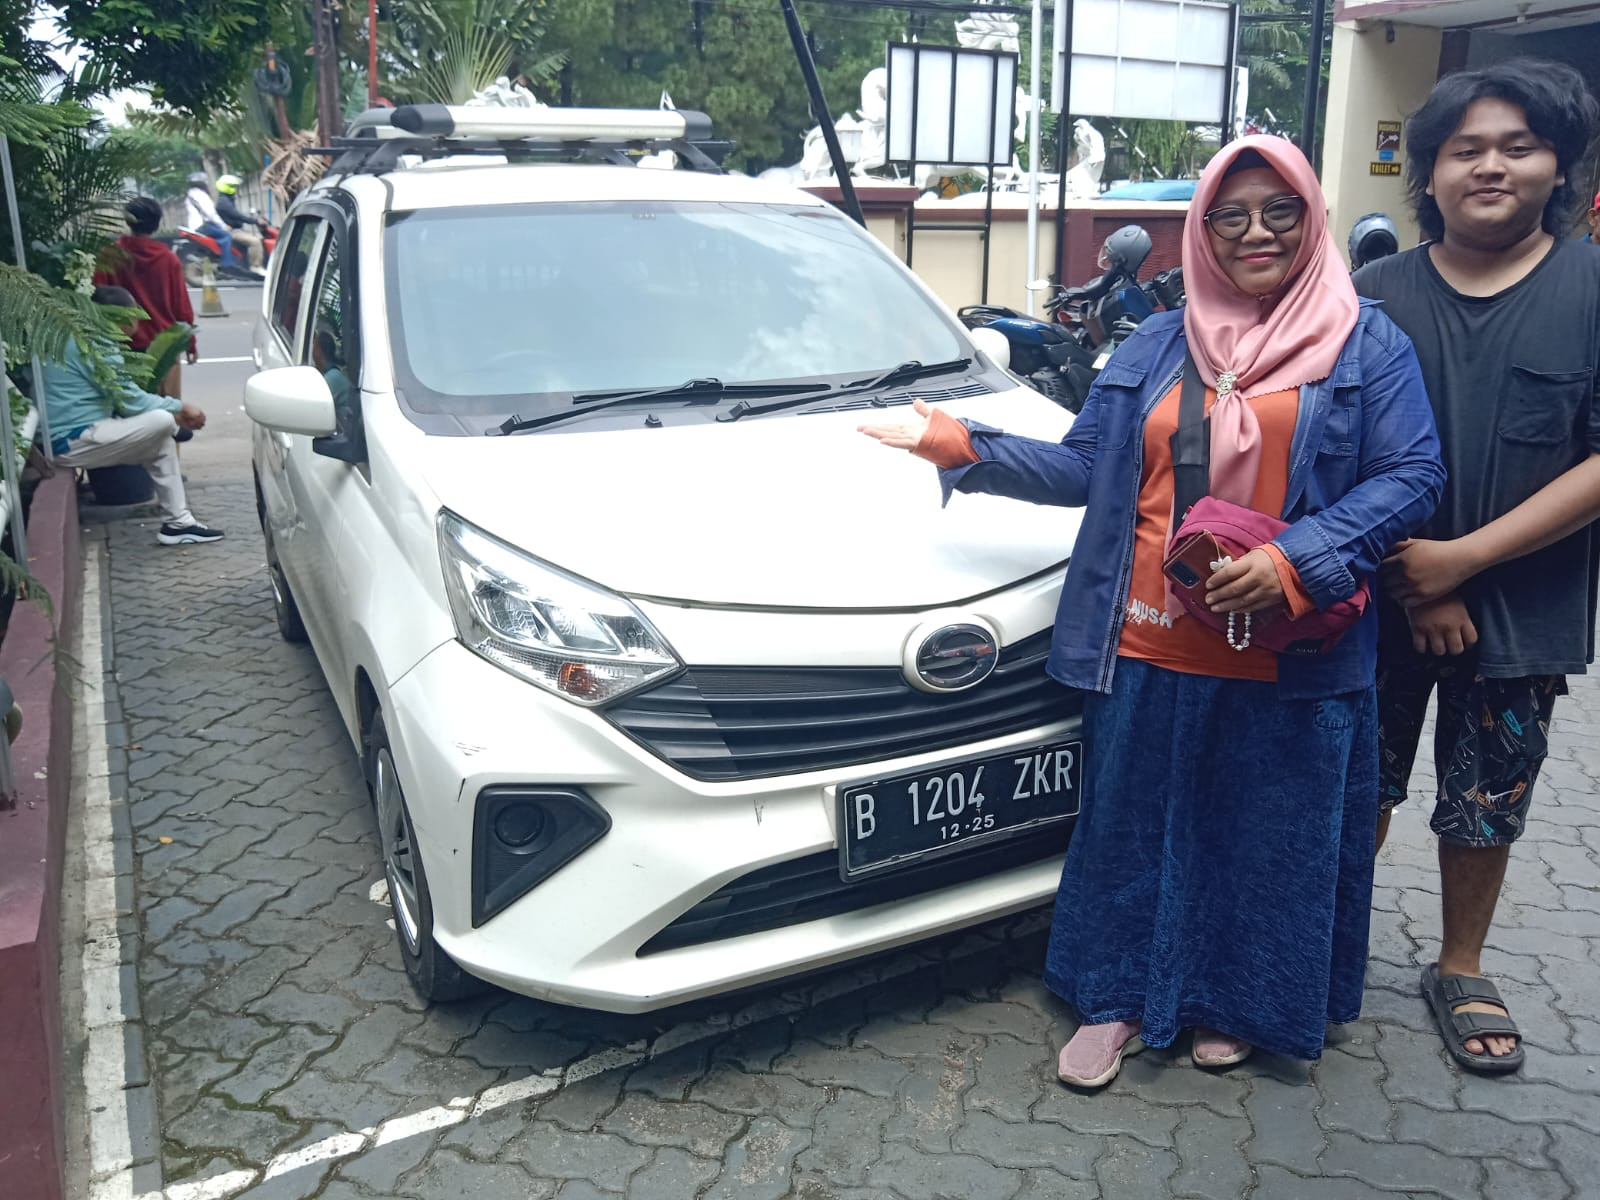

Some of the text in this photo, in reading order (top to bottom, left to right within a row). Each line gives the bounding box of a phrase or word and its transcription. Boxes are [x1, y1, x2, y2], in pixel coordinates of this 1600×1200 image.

[855, 750, 1075, 840] B 1204 ZKR
